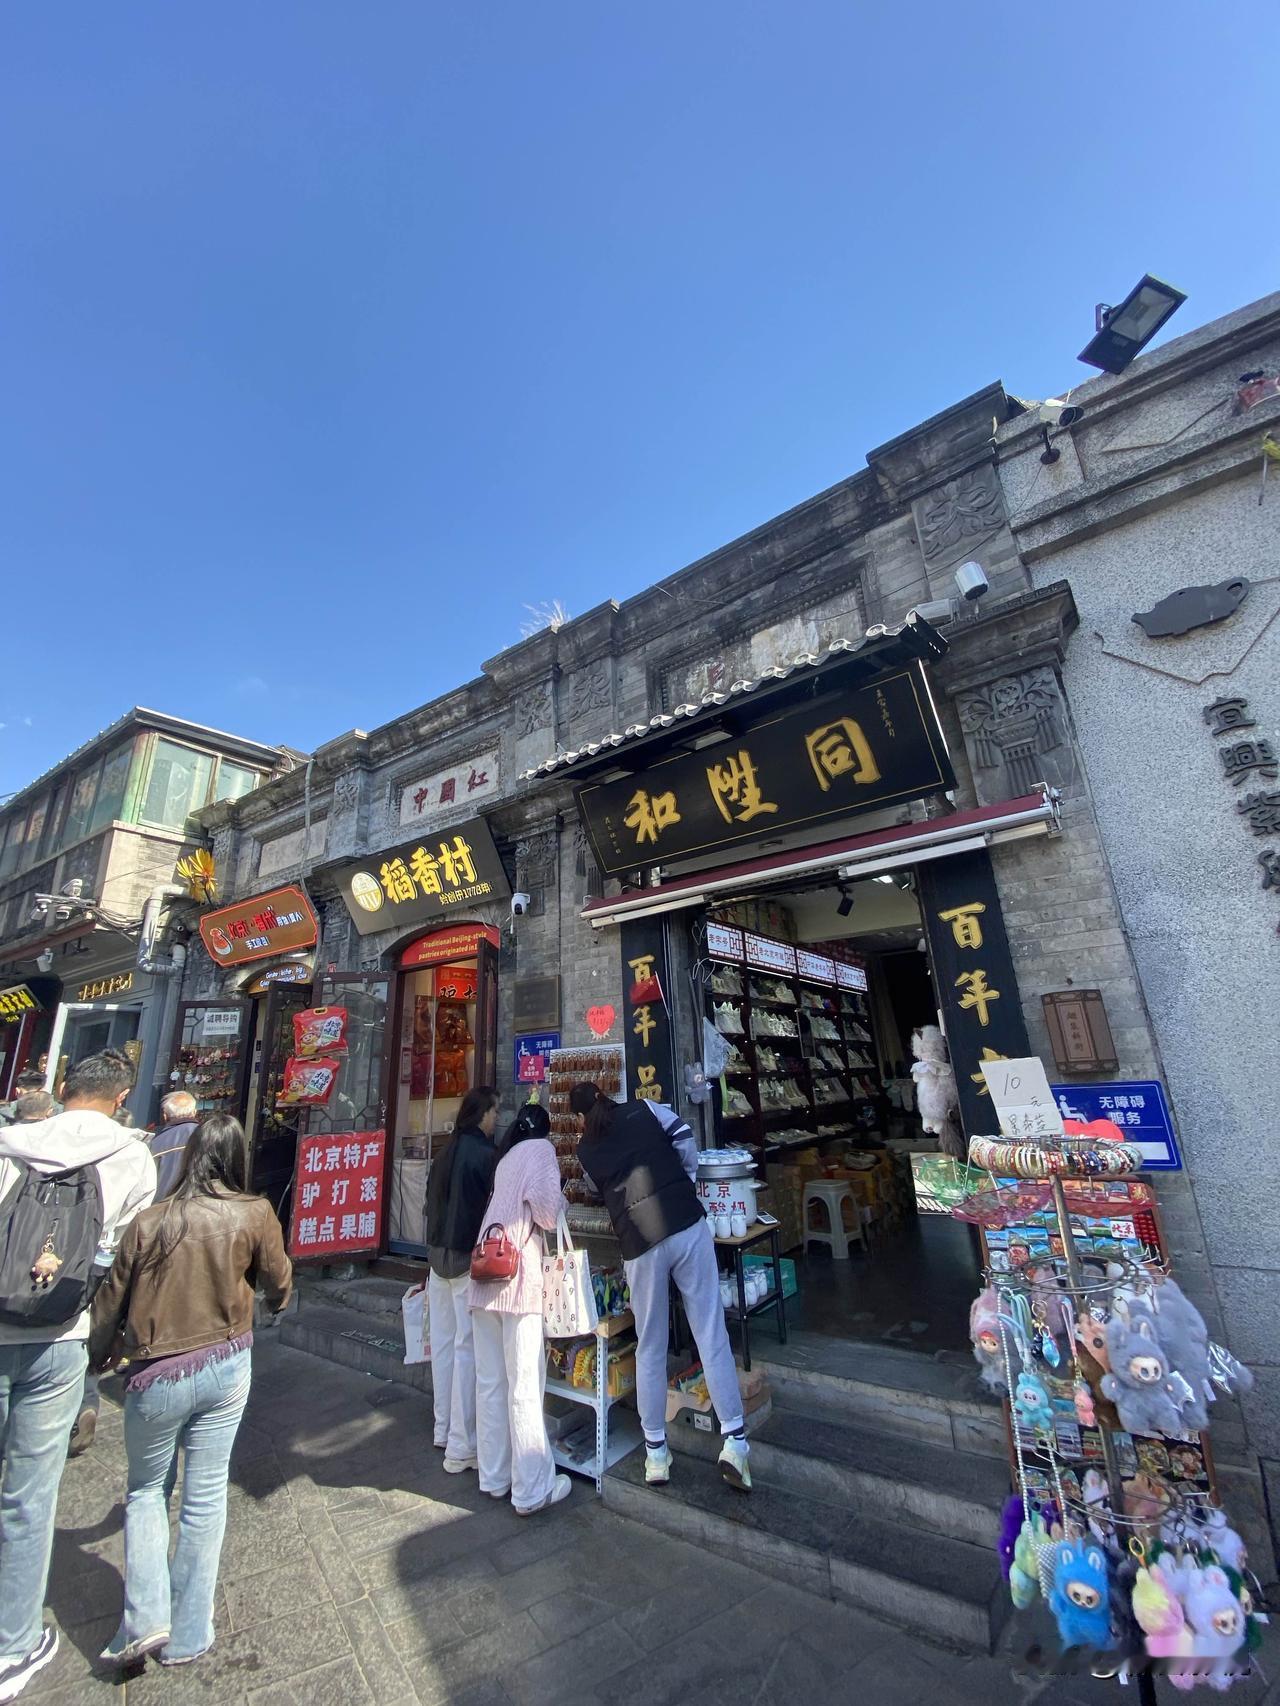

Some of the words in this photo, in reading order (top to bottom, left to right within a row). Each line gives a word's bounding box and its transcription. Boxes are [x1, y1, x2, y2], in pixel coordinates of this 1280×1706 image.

[380, 836, 477, 904] 稻香村
[423, 936, 452, 948] Traditional
[452, 931, 487, 944] Beijing-style
[418, 949, 440, 961] pastries
[439, 944, 468, 957] originated
[1003, 1072, 1021, 1096] 10
[1098, 1095, 1146, 1109] 无障碍
[1110, 1111, 1141, 1125] 服务
[304, 1141, 379, 1173] 北京特产
[301, 1175, 378, 1208] 驴打滚
[697, 1181, 731, 1198] 北京
[298, 1211, 377, 1245] 糕点果脯
